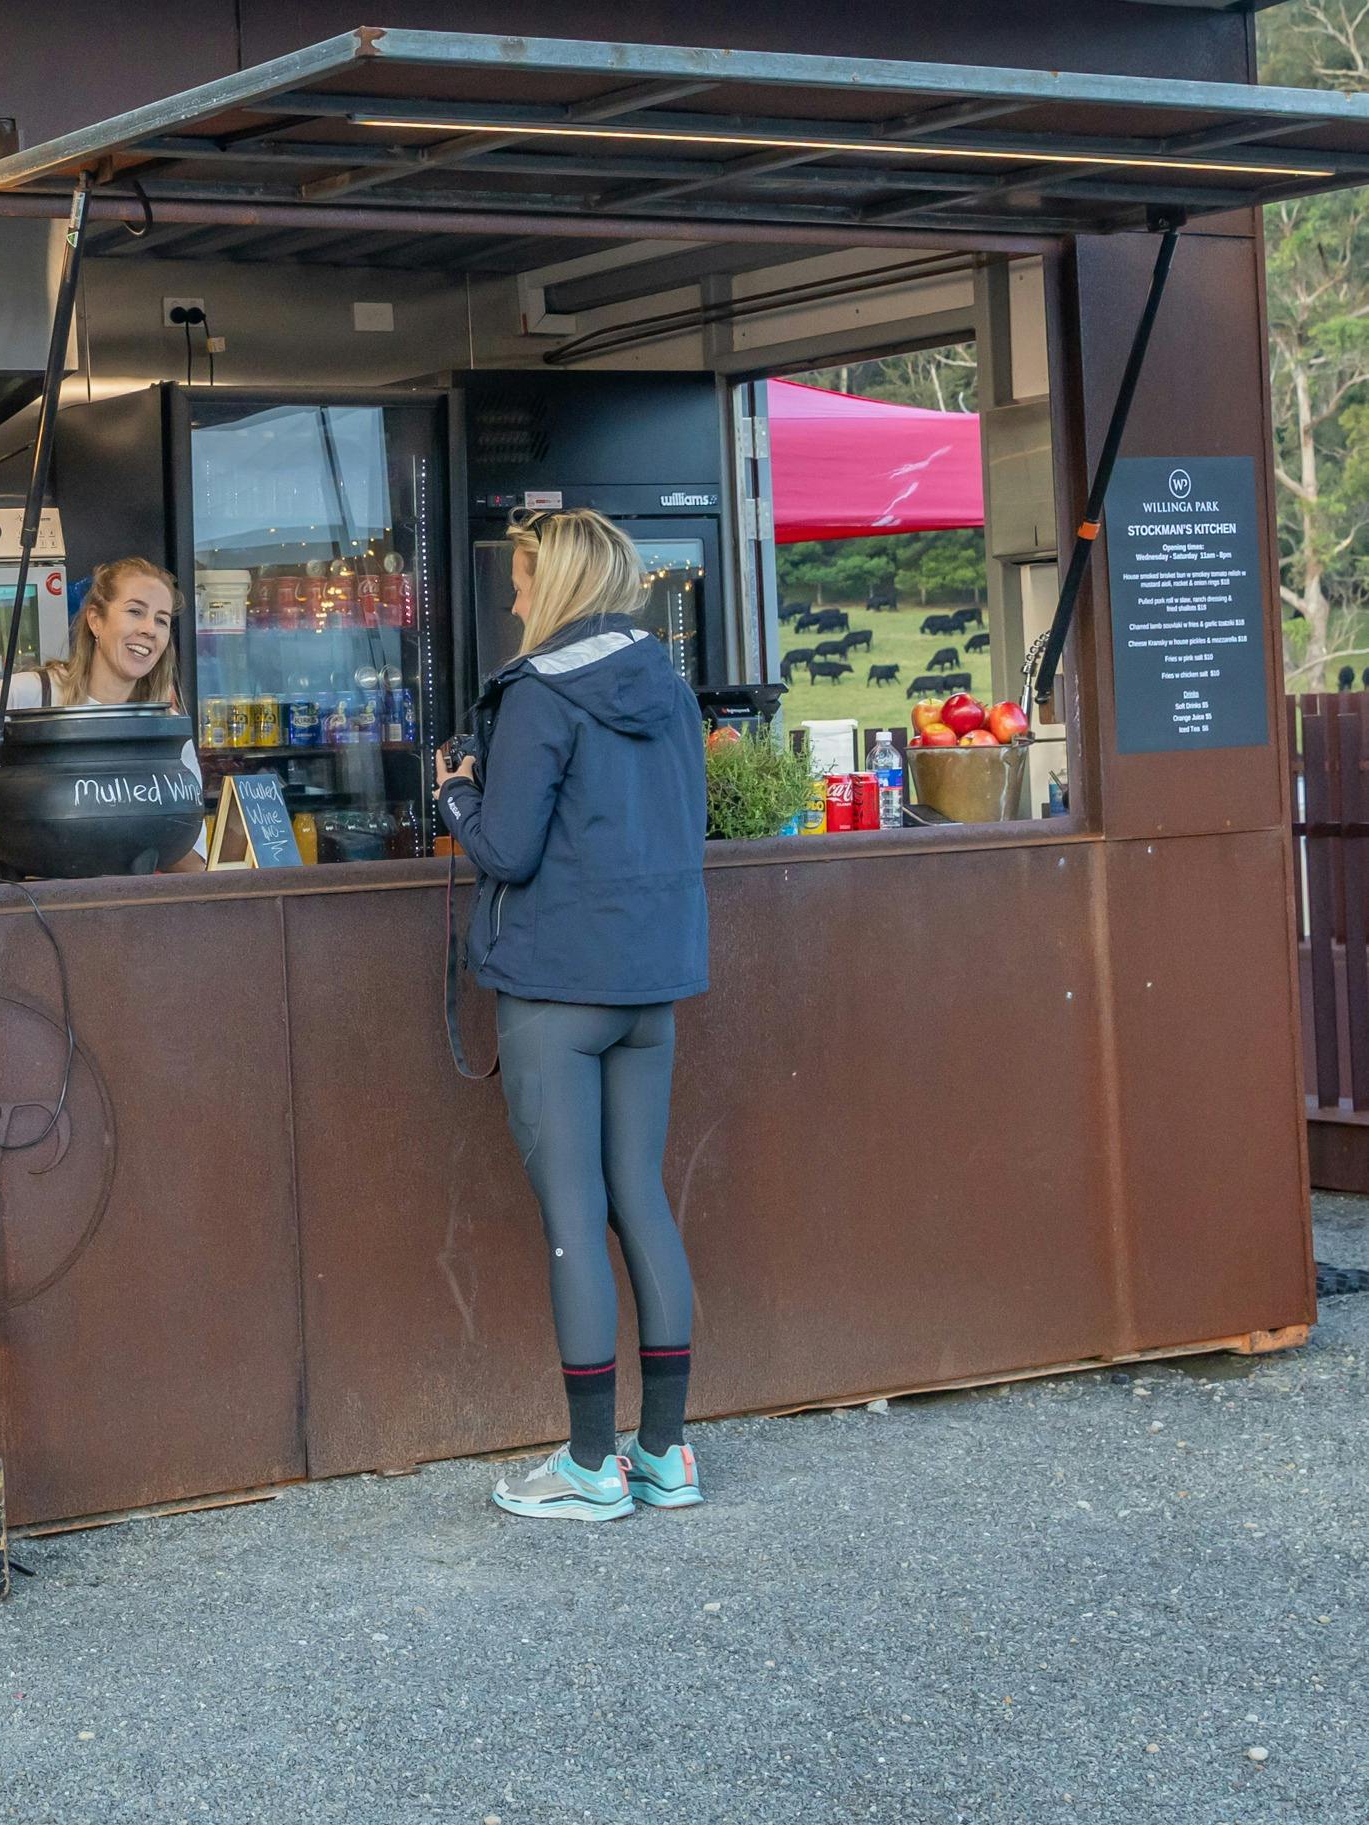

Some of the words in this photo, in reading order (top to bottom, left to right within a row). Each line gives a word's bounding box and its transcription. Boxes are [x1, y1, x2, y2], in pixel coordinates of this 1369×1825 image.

[1142, 501, 1193, 513] WILLINGA
[1195, 501, 1220, 512] PARK
[1127, 523, 1193, 536] STOCKMAN'S
[1194, 523, 1237, 535] KITCHEN
[74, 774, 162, 807] Mulled
[238, 780, 284, 806] Mulled
[245, 802, 282, 825] Wine
